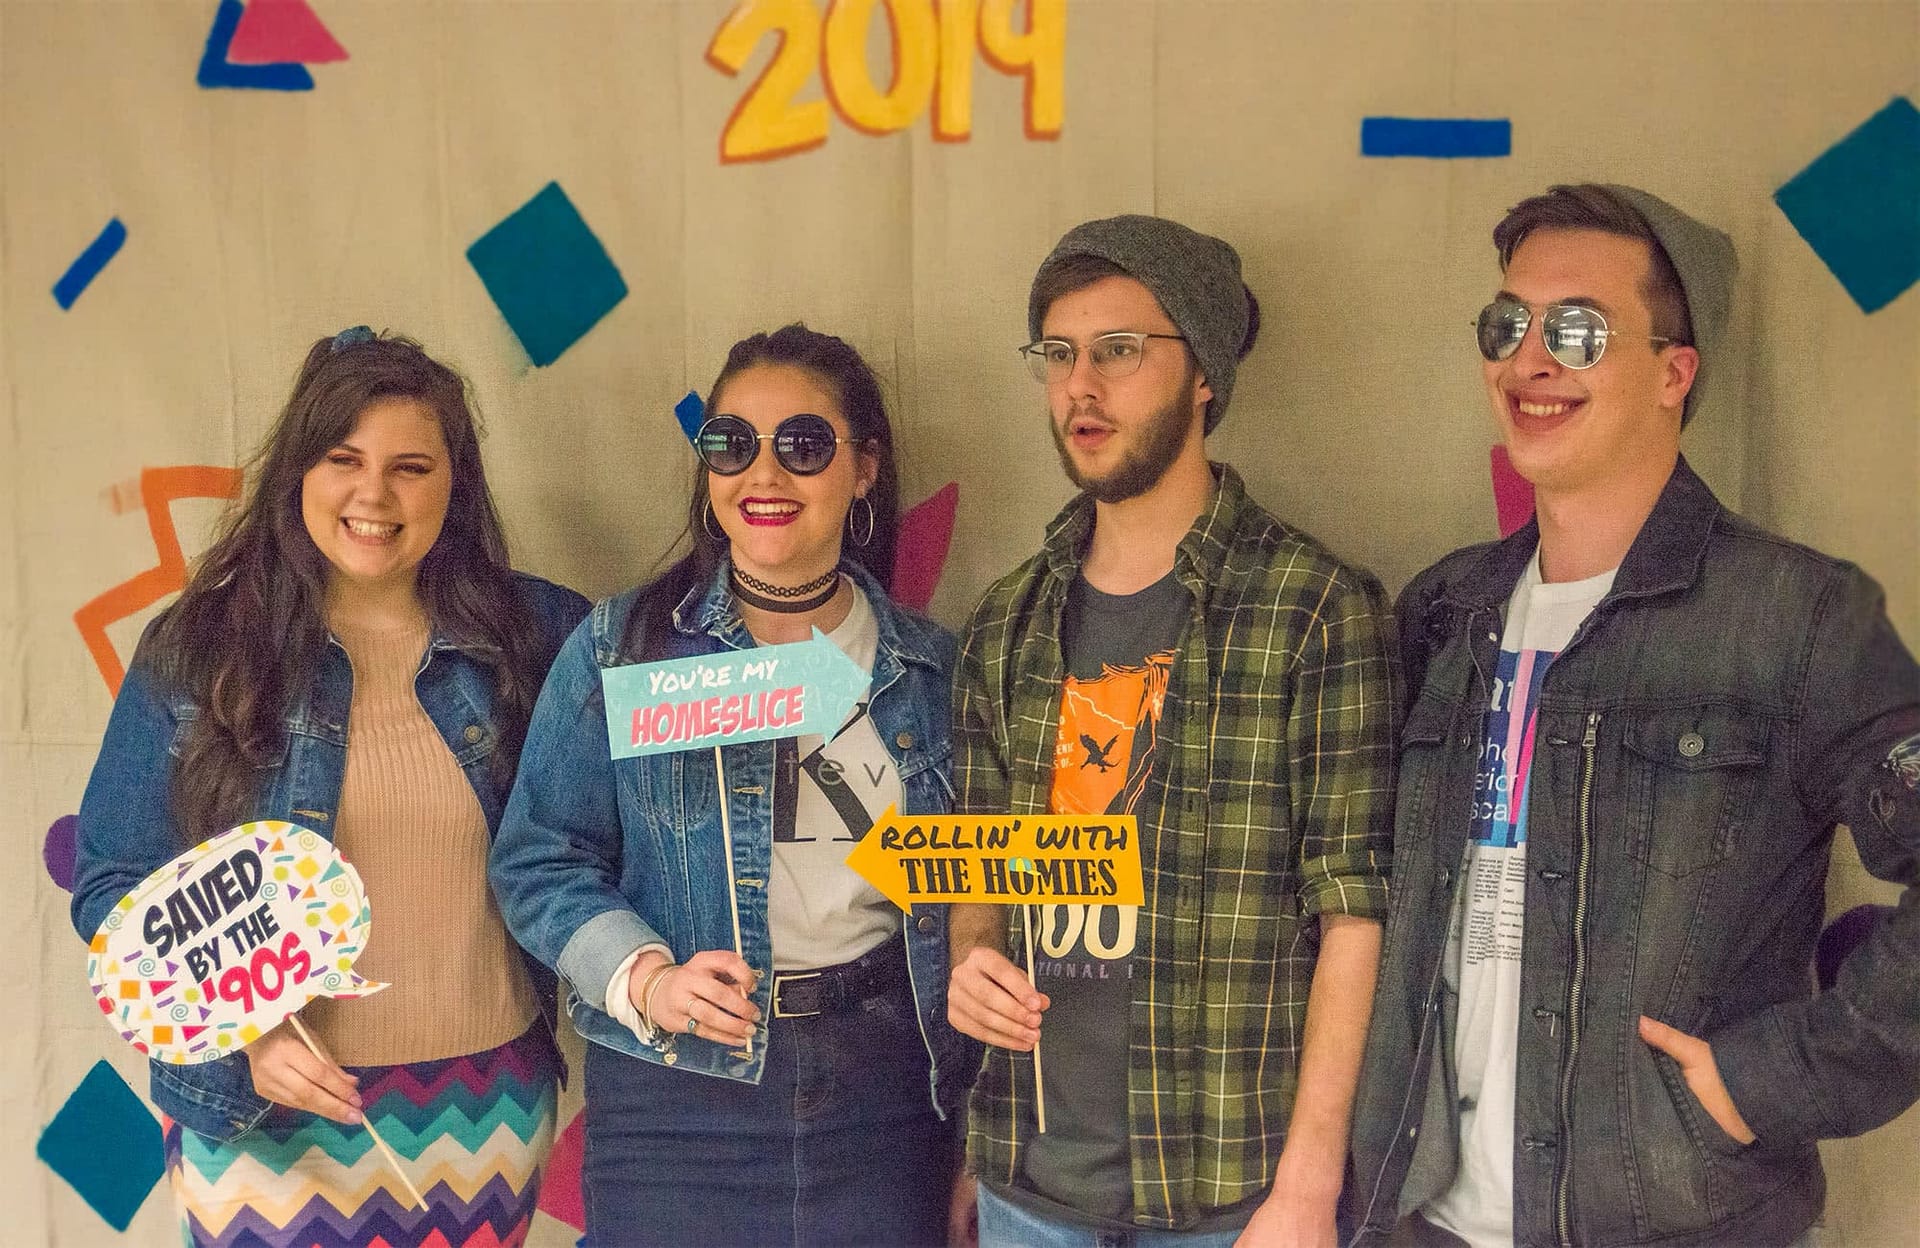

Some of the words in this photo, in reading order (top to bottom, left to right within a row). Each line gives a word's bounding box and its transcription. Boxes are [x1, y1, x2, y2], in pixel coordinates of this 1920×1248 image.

[704, 0, 1068, 165] 2019
[649, 666, 731, 696] YOU'RE
[741, 659, 779, 681] MY
[630, 684, 806, 748] HOMESLICE
[880, 820, 1021, 851] ROLLIN'
[1035, 825, 1128, 850] WITH
[143, 849, 263, 958] SAVED
[900, 858, 972, 895] THE
[981, 857, 1118, 897] HOMIES
[184, 936, 222, 984] BY
[223, 902, 281, 957] THE
